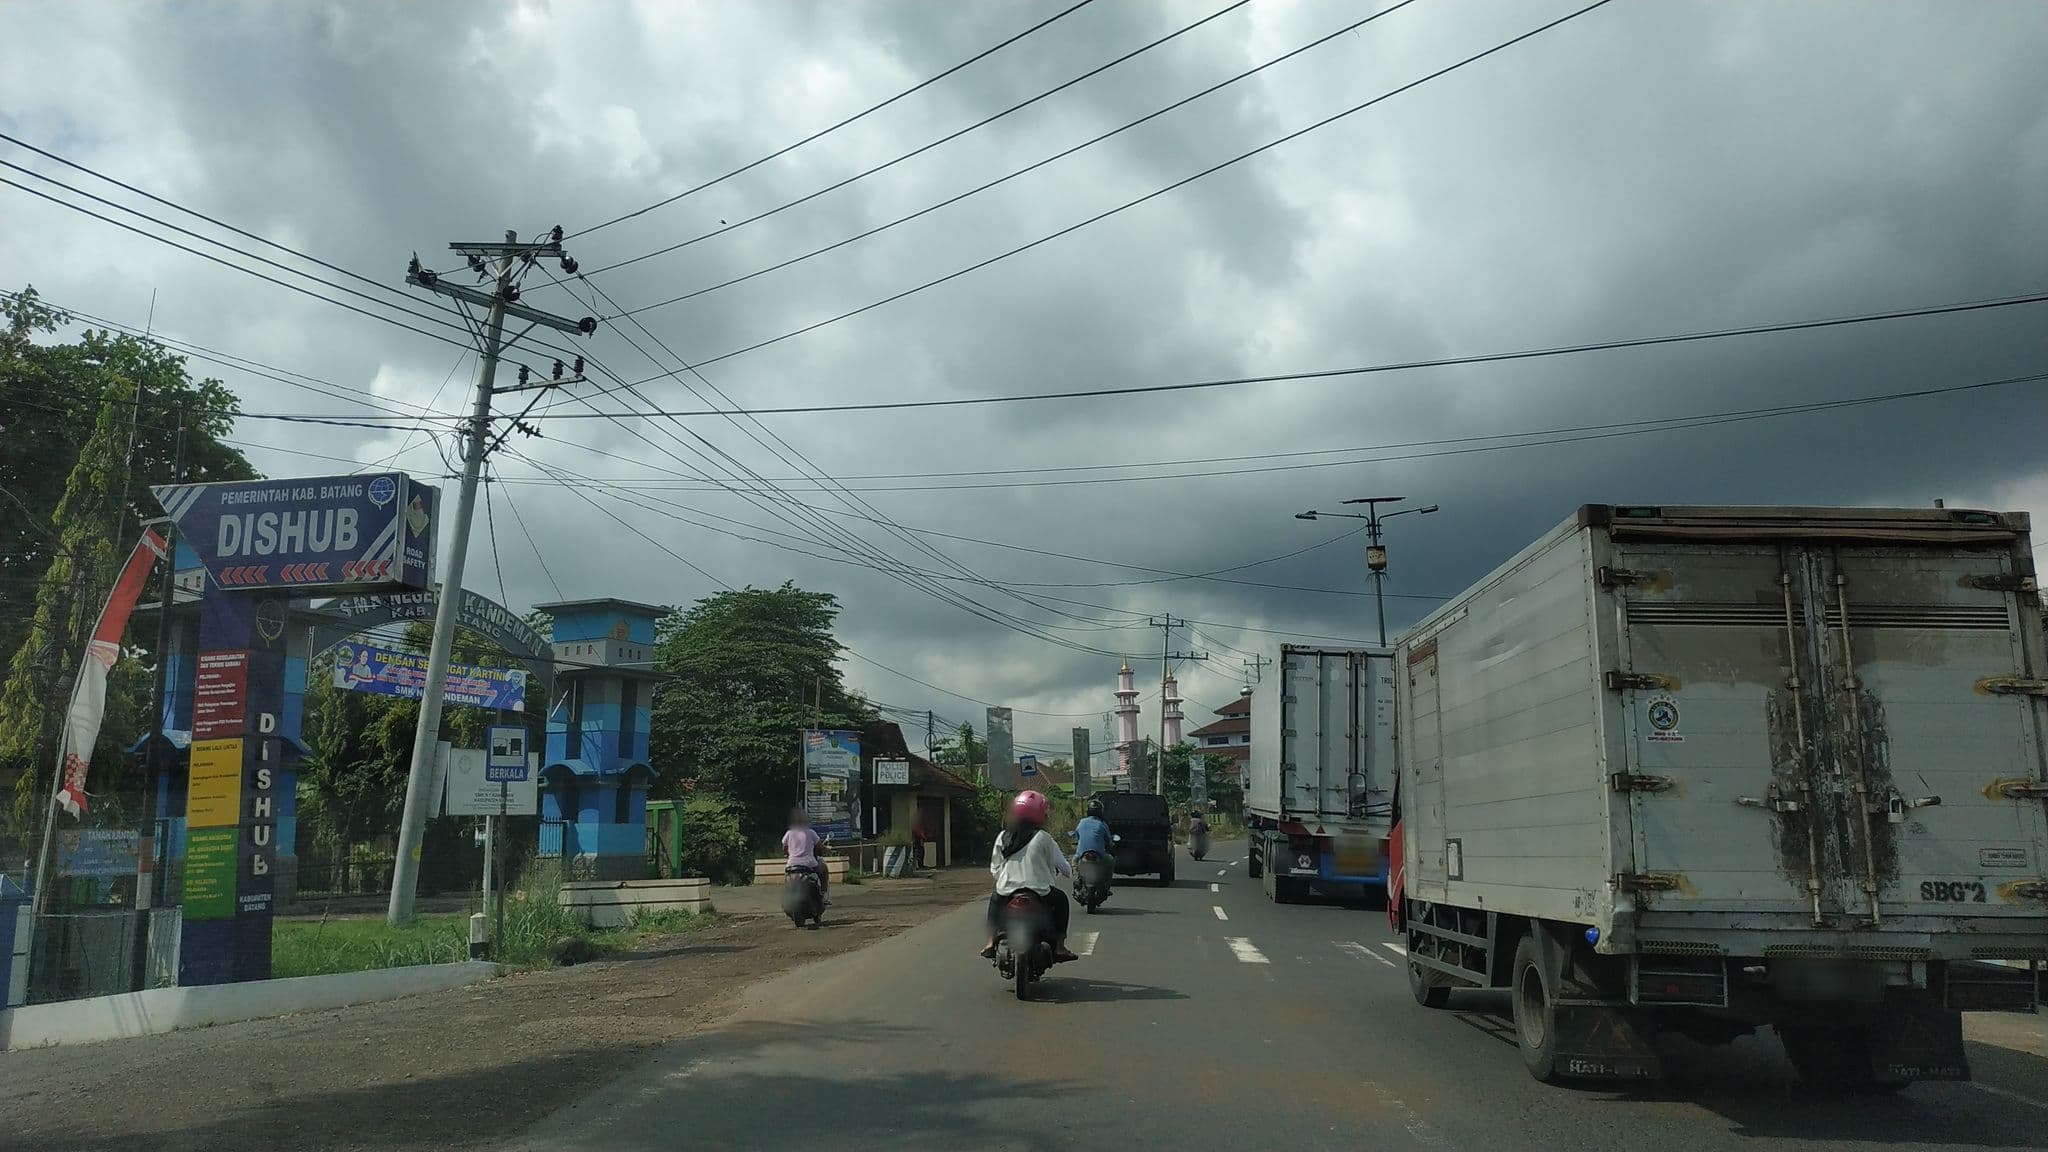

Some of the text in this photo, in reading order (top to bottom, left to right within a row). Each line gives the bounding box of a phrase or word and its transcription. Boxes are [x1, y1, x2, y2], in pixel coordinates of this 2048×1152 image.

[221, 483, 363, 505] PEMERINTAH KAB. BATANG
[216, 507, 360, 558] DISHUB
[406, 546, 424, 559] ROAD
[455, 611, 502, 638] ATANG
[464, 593, 543, 657] KANDEMAN
[375, 652, 416, 668] DENGAN
[489, 768, 524, 779] BERKALA
[880, 771, 907, 780] POLICE
